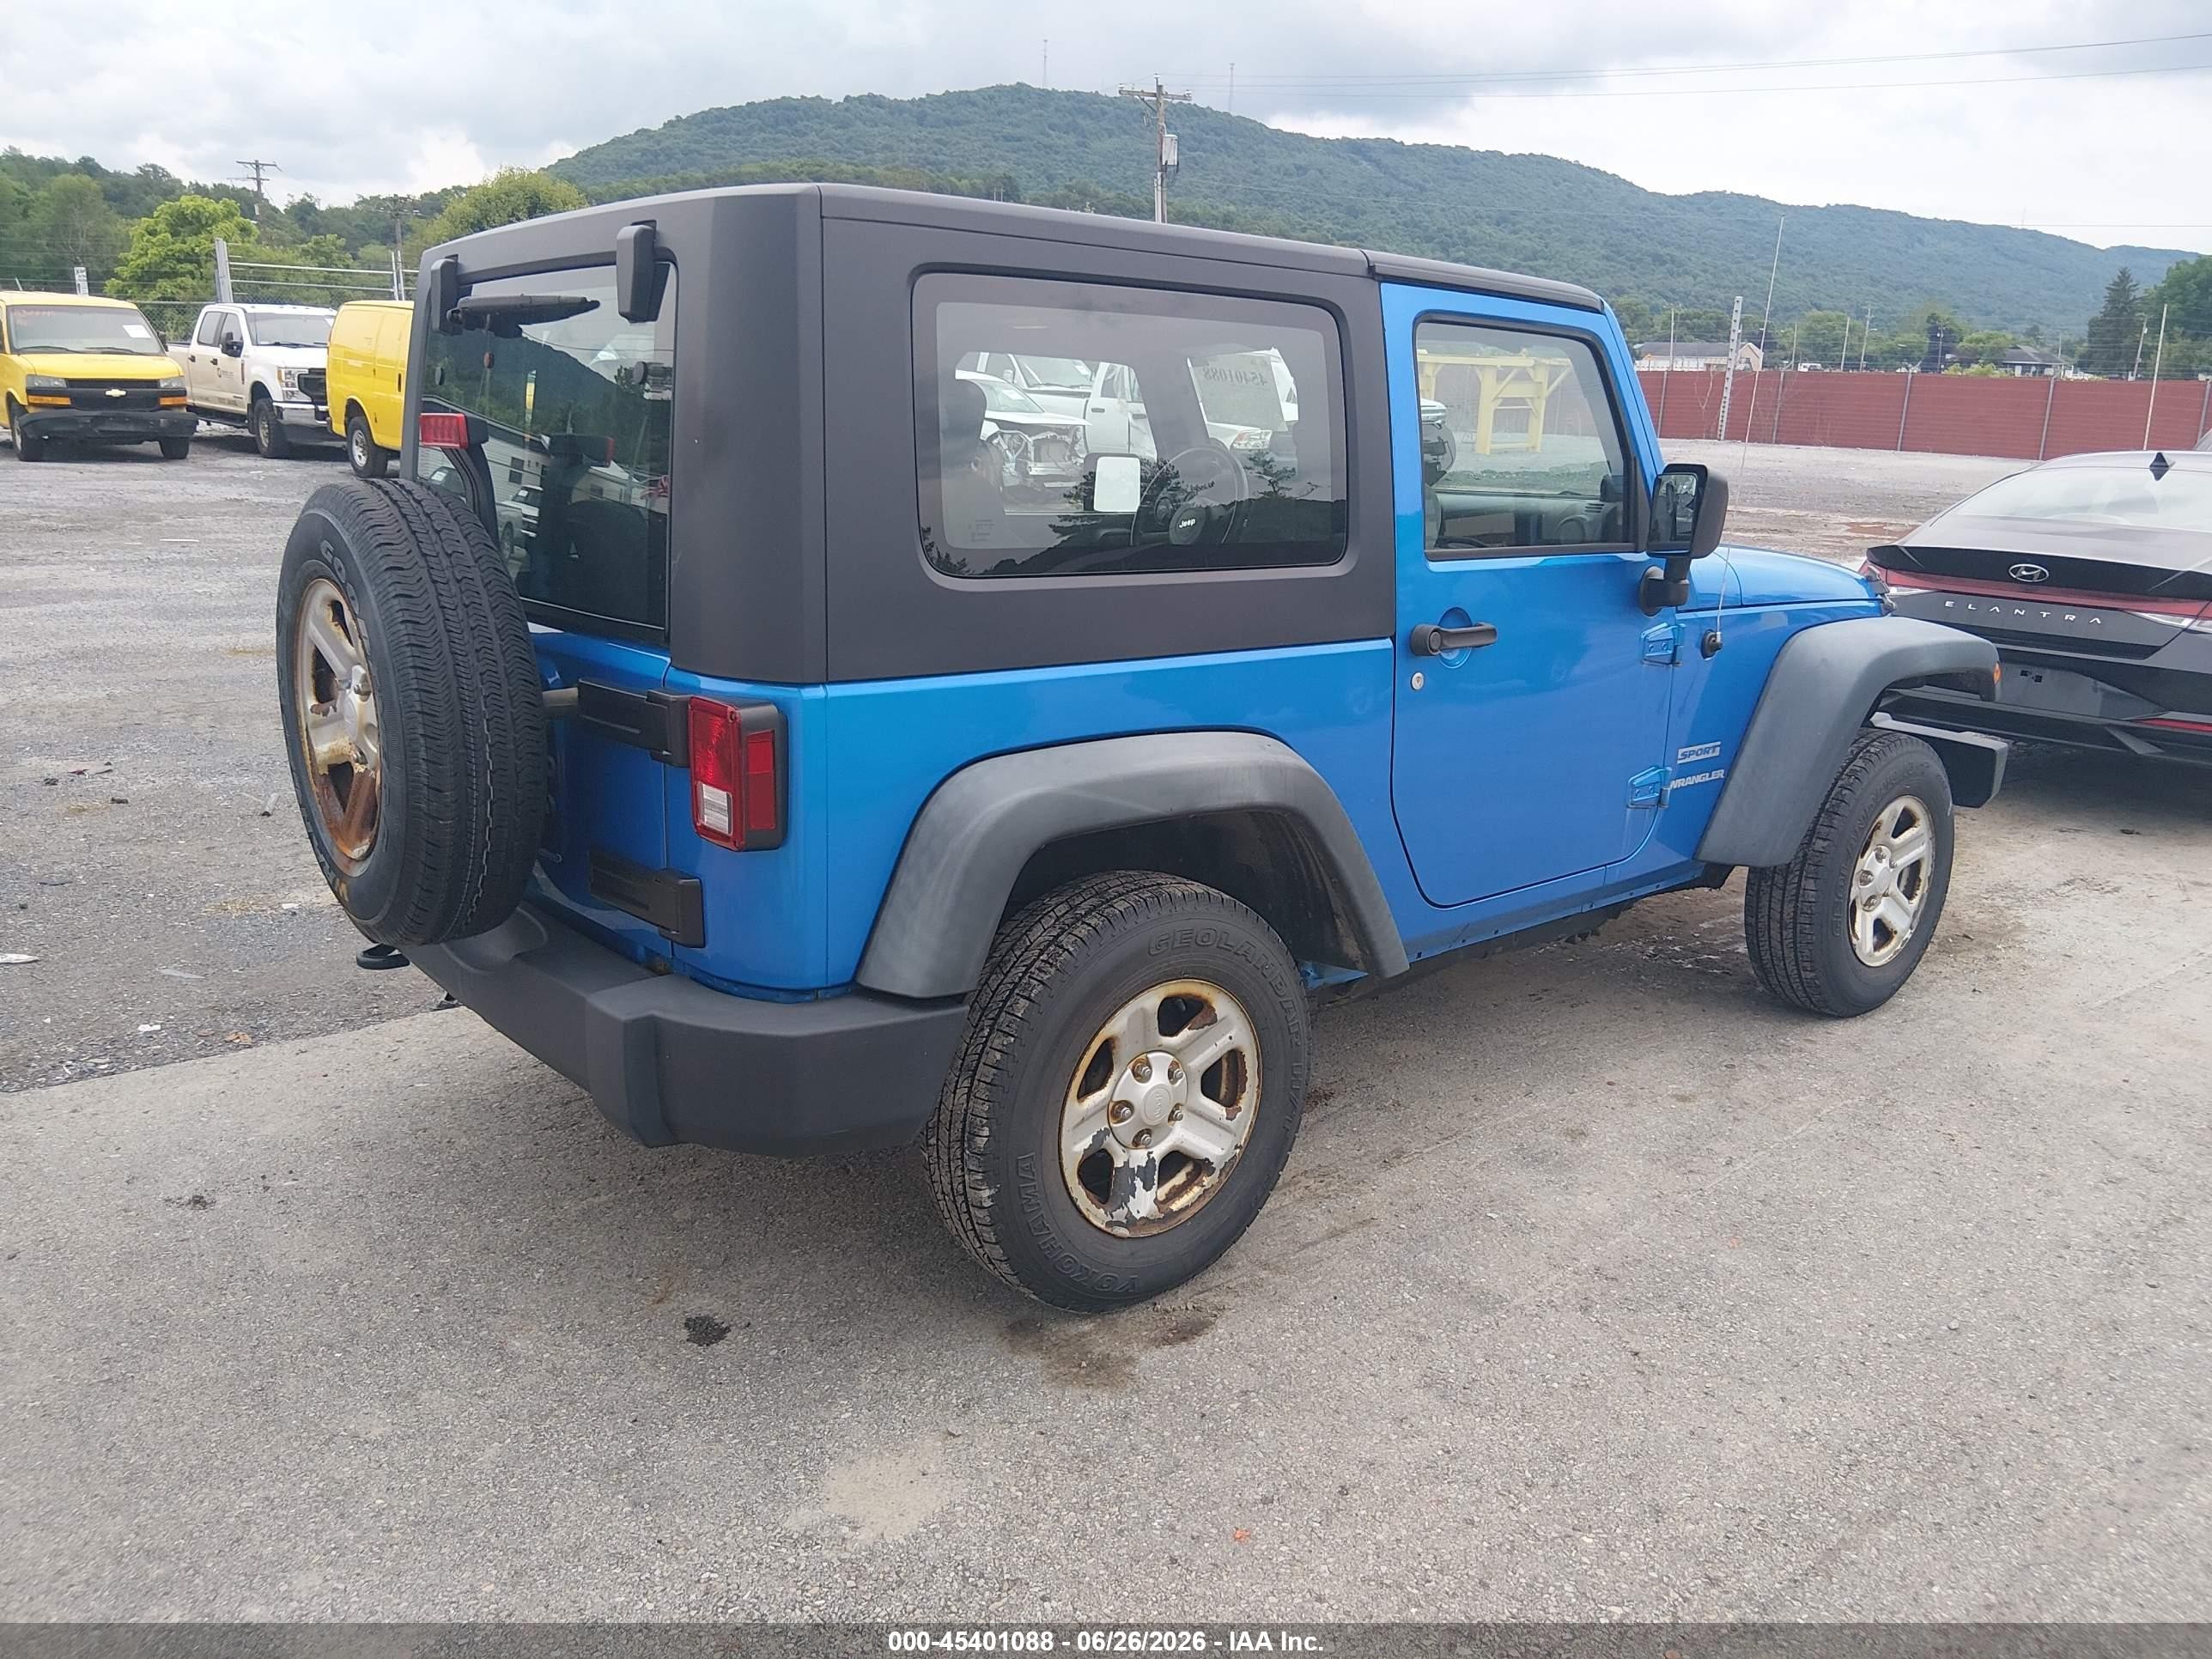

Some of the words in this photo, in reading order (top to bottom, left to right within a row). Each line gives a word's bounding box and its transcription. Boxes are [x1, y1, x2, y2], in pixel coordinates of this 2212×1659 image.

[1178, 518, 1196, 528] Jeep
[1944, 600, 2102, 624] ELANTRA
[1678, 744, 1720, 761] SPORT
[1669, 769, 1725, 789] WRANGLER
[1147, 927, 1302, 1048] GEOLANDAR
[1017, 1152, 1140, 1292] YOKOHAMA
